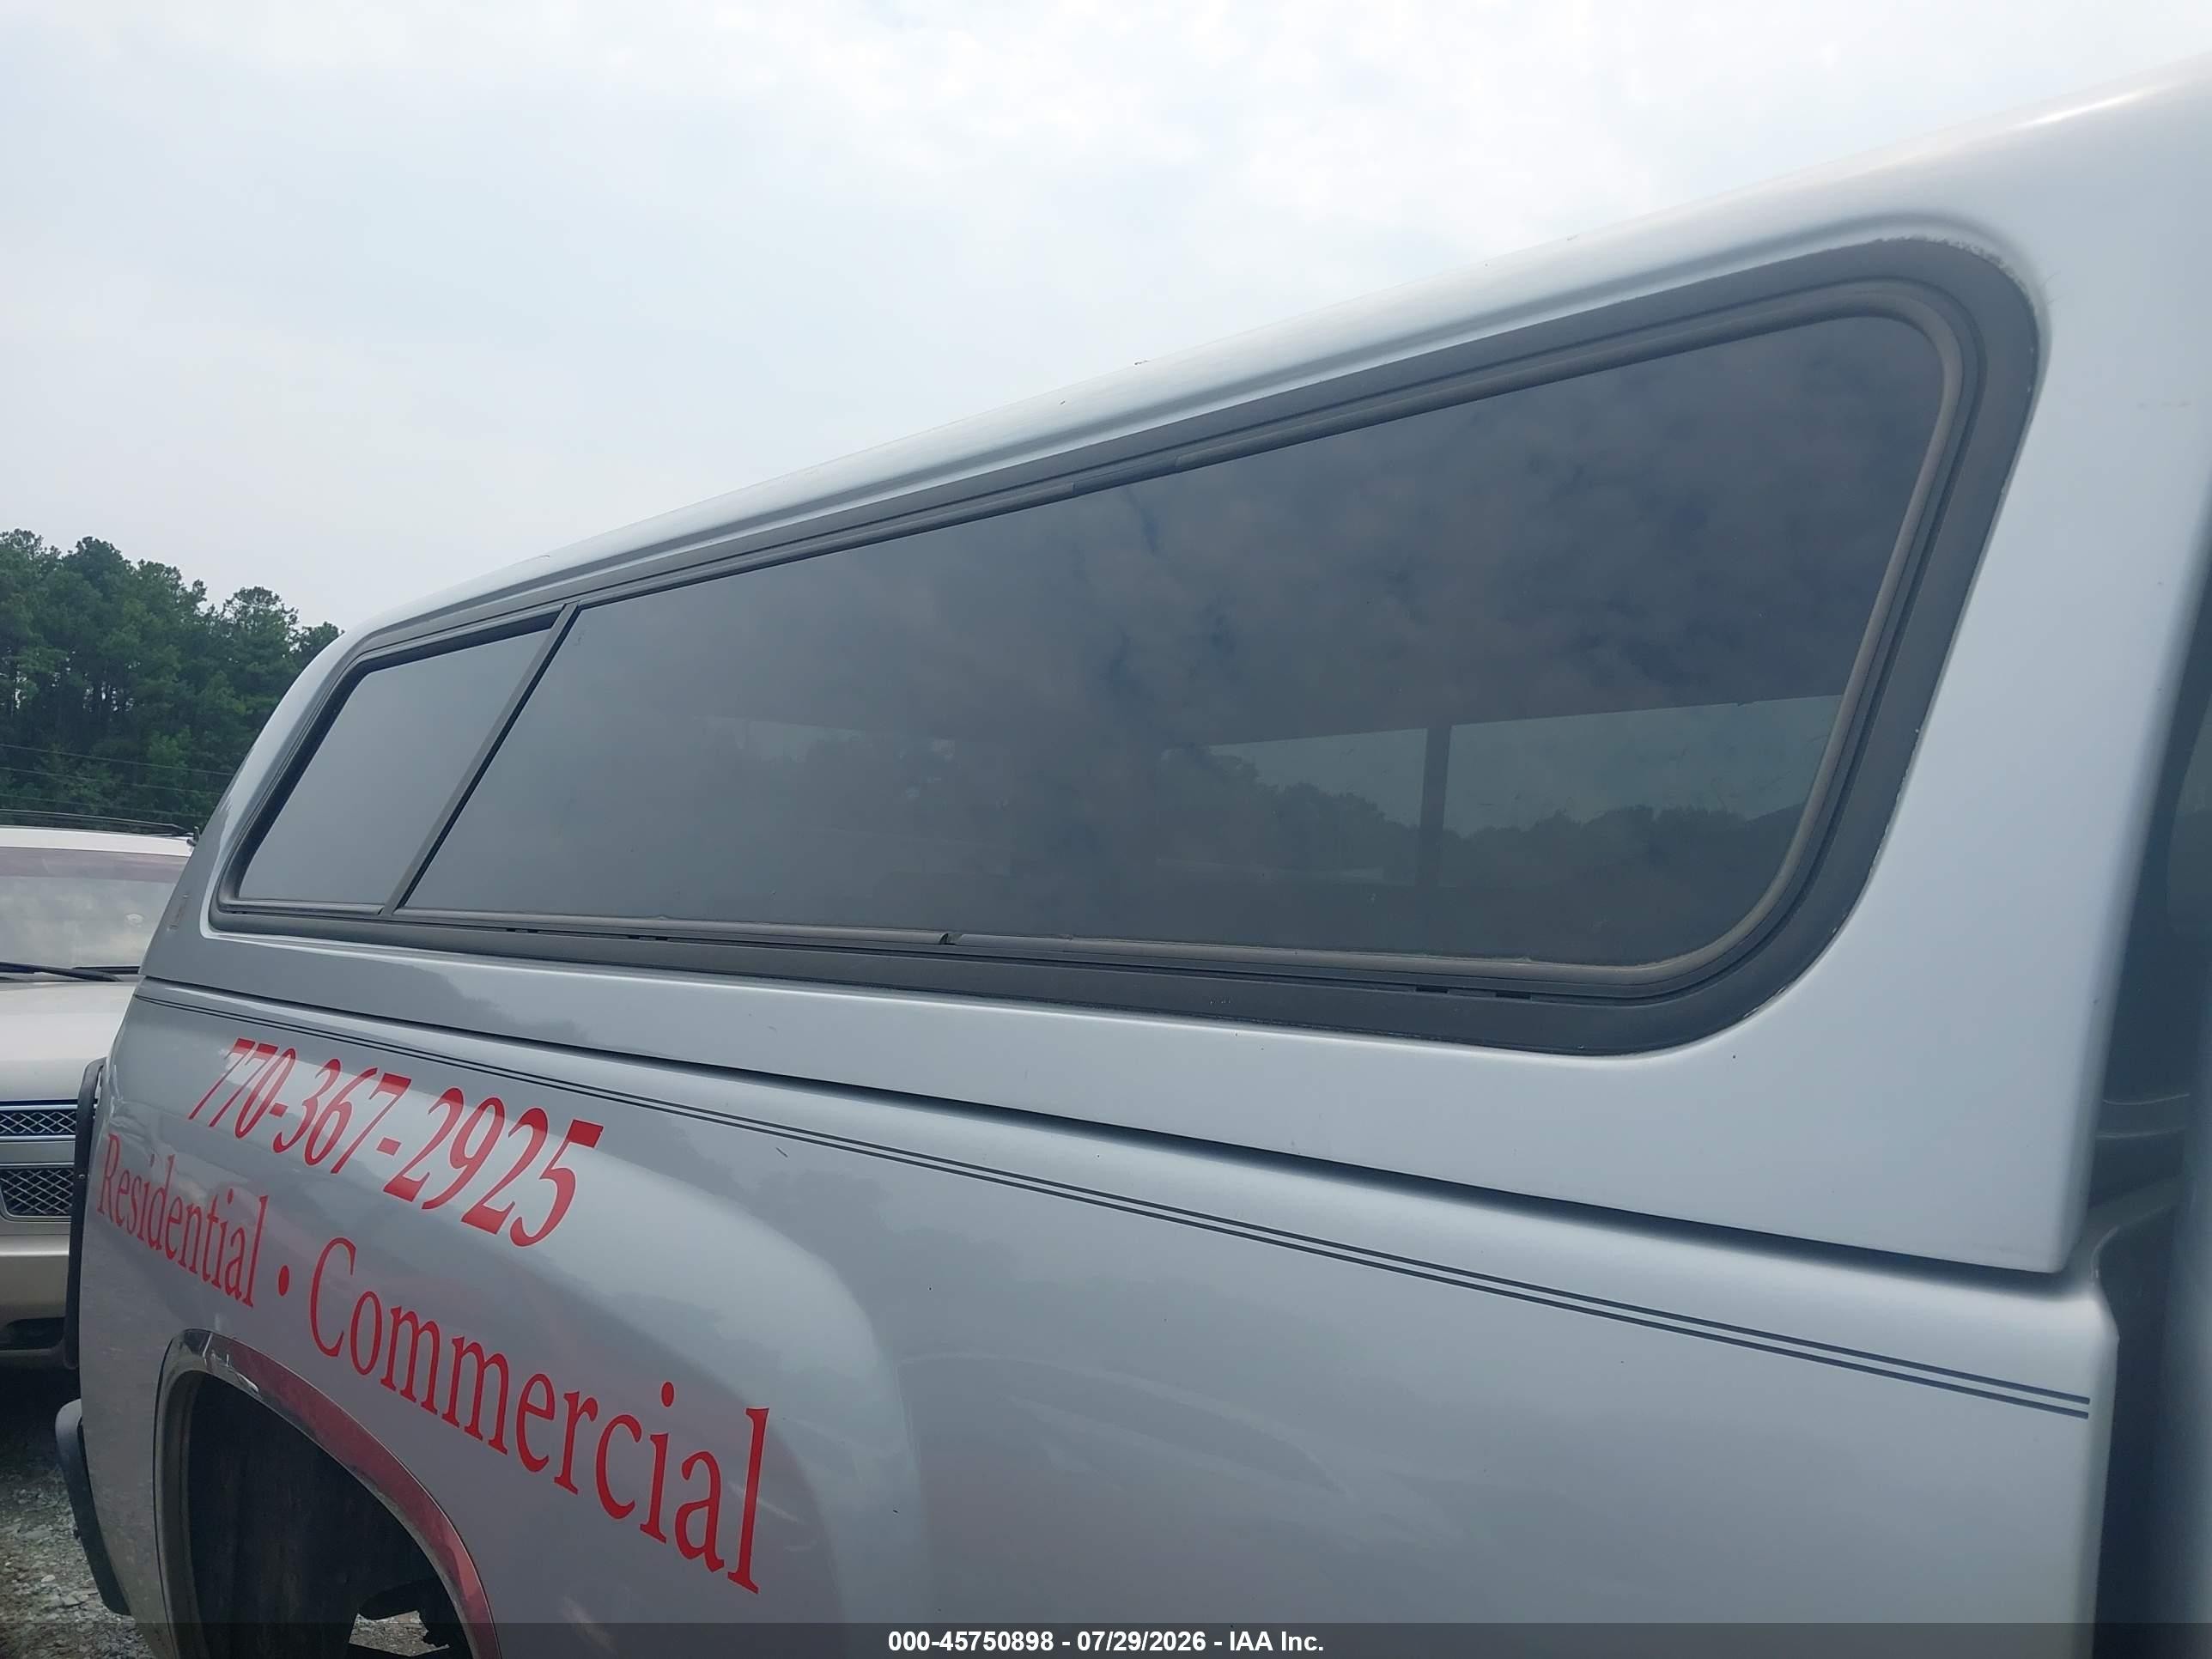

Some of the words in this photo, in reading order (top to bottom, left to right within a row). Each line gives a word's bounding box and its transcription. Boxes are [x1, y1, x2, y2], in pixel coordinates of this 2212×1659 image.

[189, 1036, 605, 1248] 770-367-2925
[96, 1133, 269, 1308] Residential
[309, 1237, 769, 1595] Commercial
